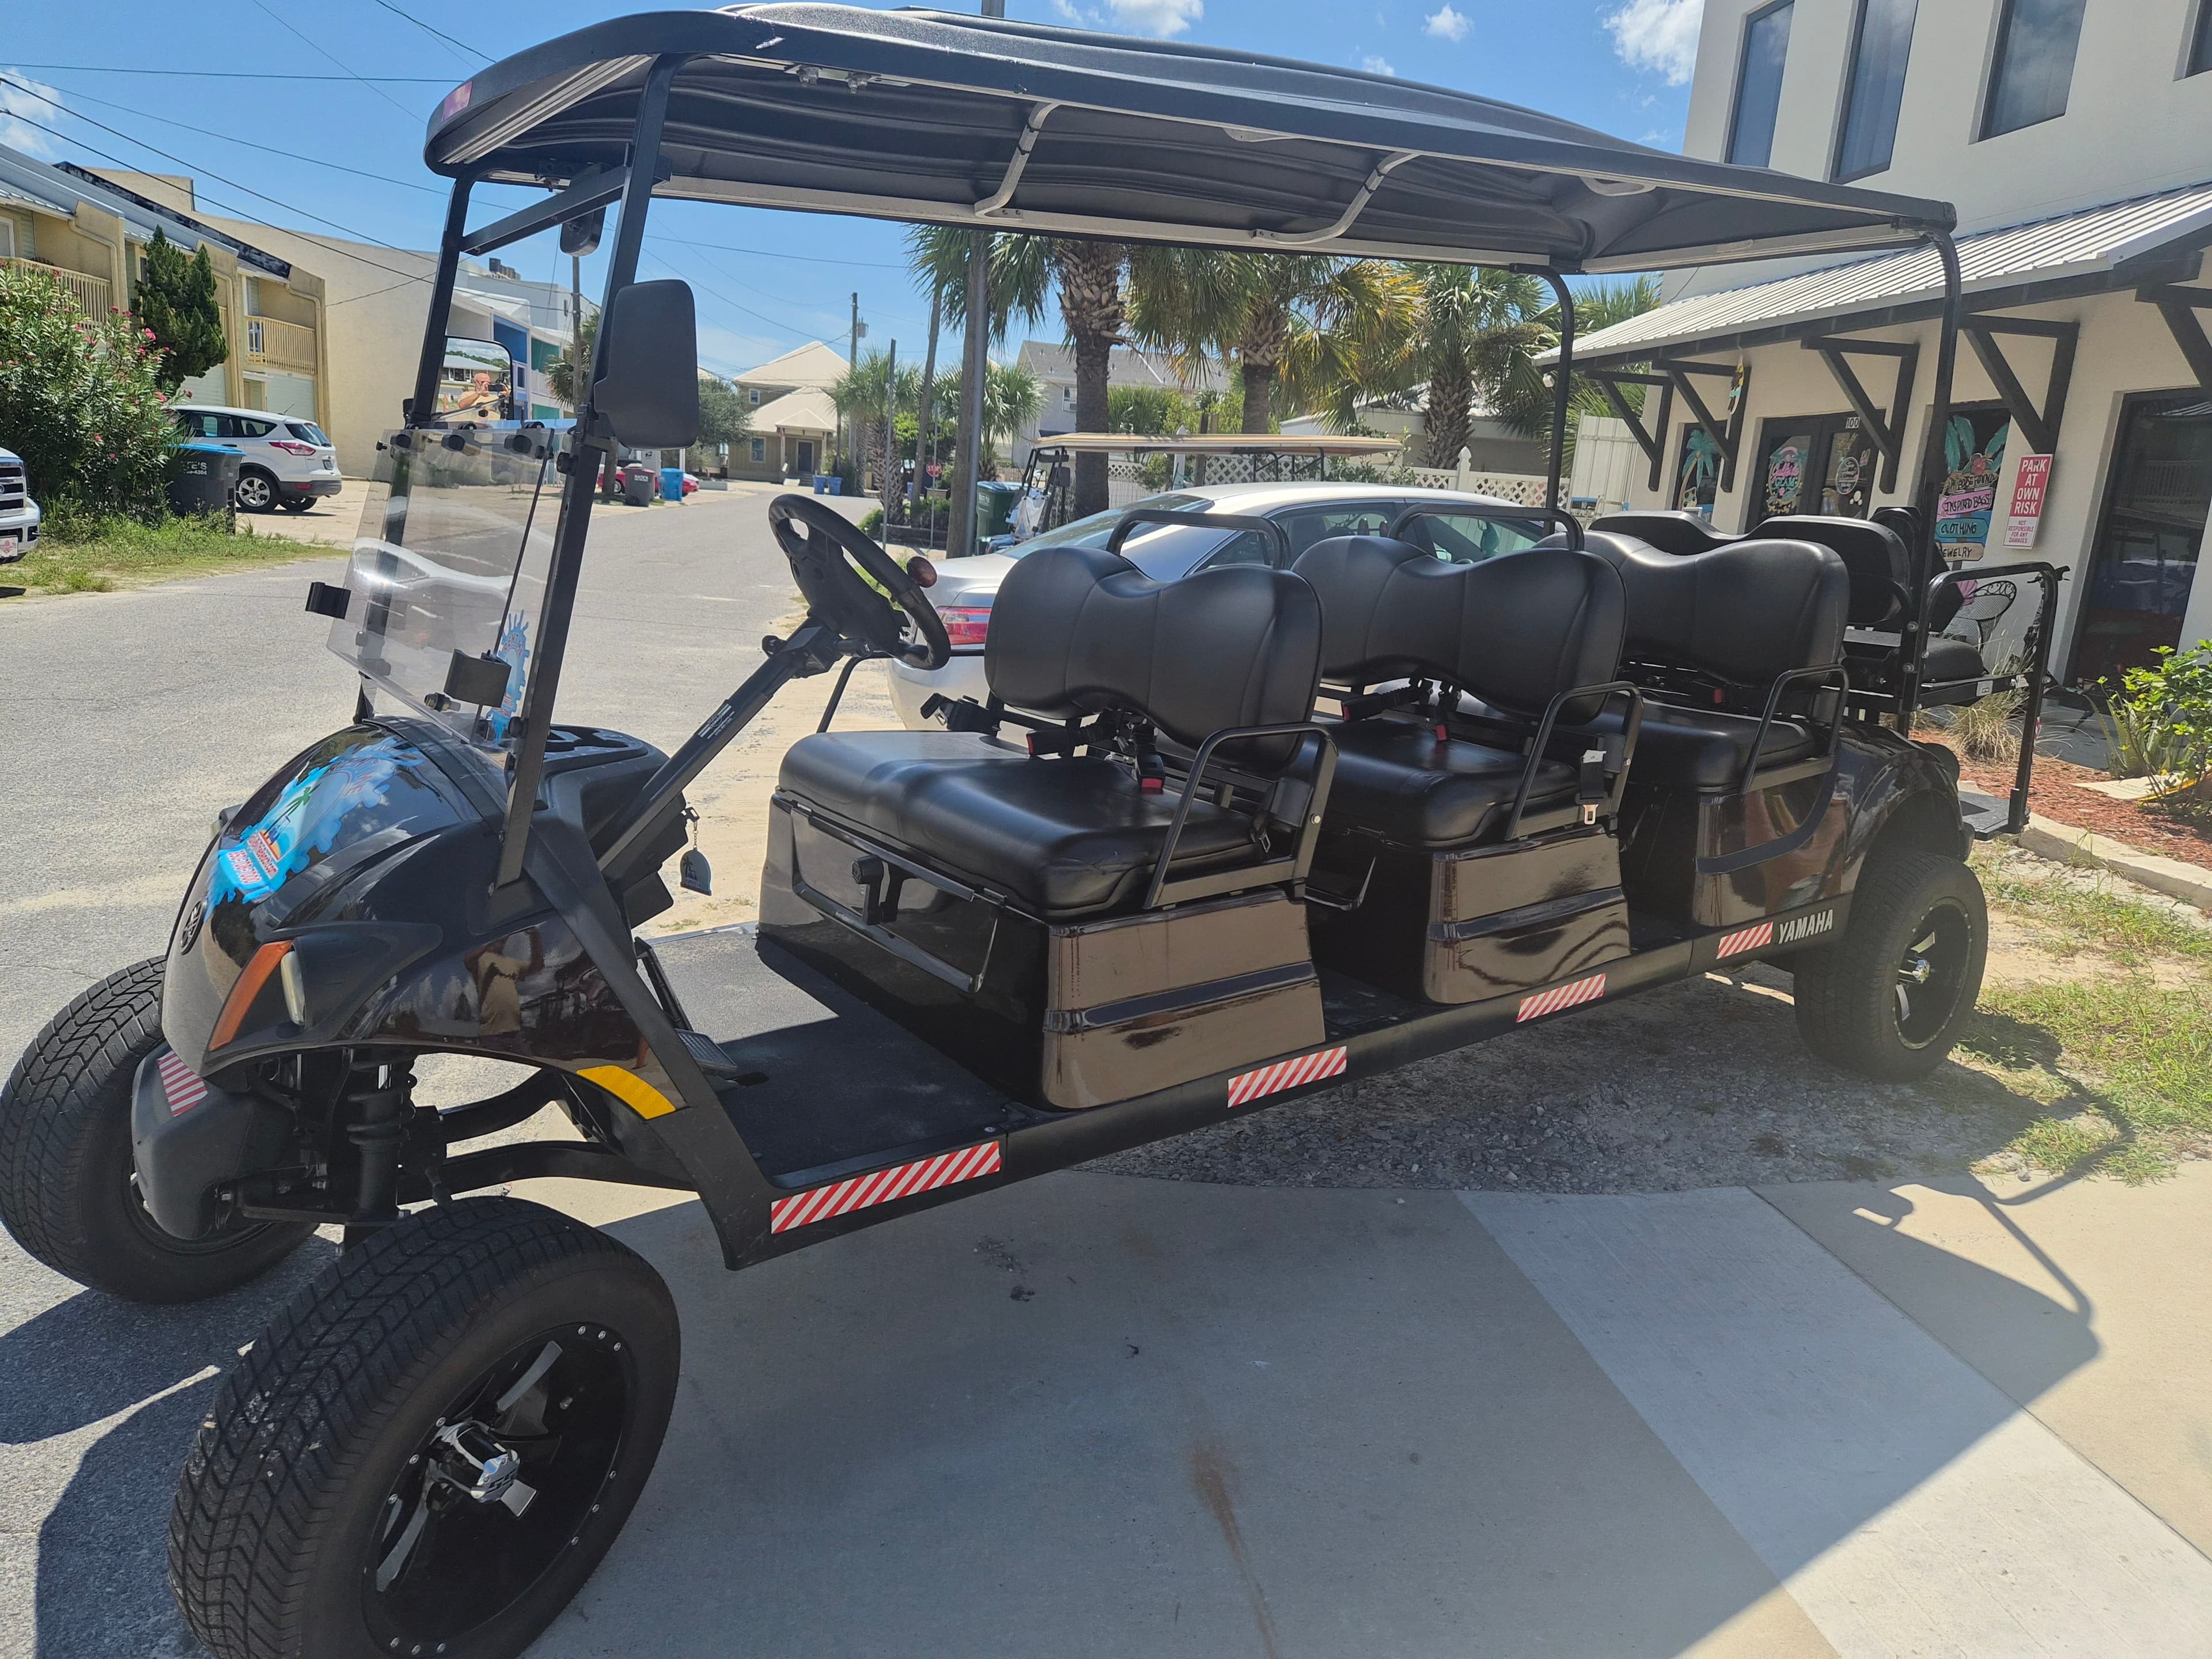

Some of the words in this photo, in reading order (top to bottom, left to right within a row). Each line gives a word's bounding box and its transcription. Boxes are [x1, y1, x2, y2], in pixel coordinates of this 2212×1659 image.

[1846, 418, 1859, 427] 100
[2021, 459, 2047, 472] PARK
[2025, 474, 2038, 487] AT
[2017, 487, 2040, 501] OWN
[2014, 502, 2037, 514] RISK
[1941, 522, 1977, 535] CLOTHING
[1942, 547, 1972, 558] EWELRY
[1778, 908, 1834, 945] YAMAHA
